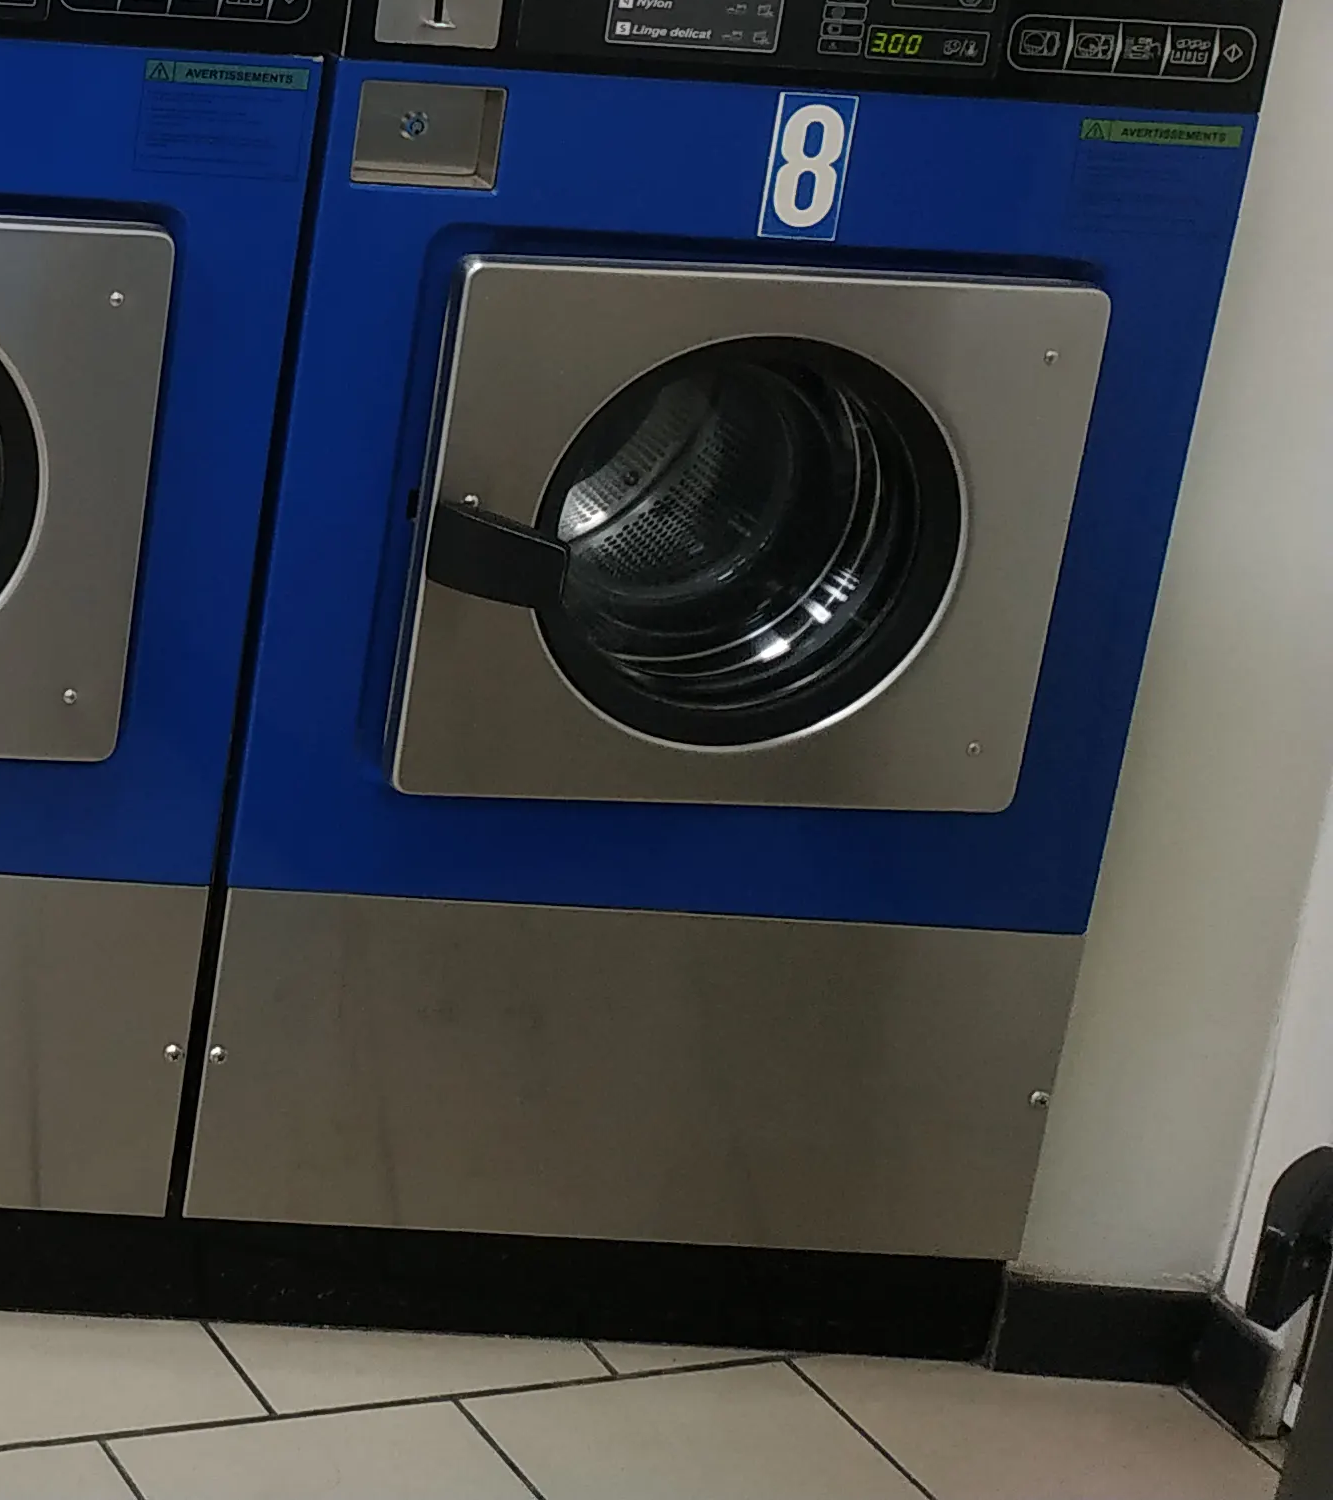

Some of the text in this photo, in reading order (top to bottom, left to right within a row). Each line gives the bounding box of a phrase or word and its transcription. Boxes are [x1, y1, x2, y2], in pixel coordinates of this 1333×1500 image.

[632, 25, 667, 38] Linge
[185, 68, 293, 84] AVERTISSEMENTS
[1121, 128, 1226, 143] AVERTISSEMENTS
[773, 104, 845, 228] 8
